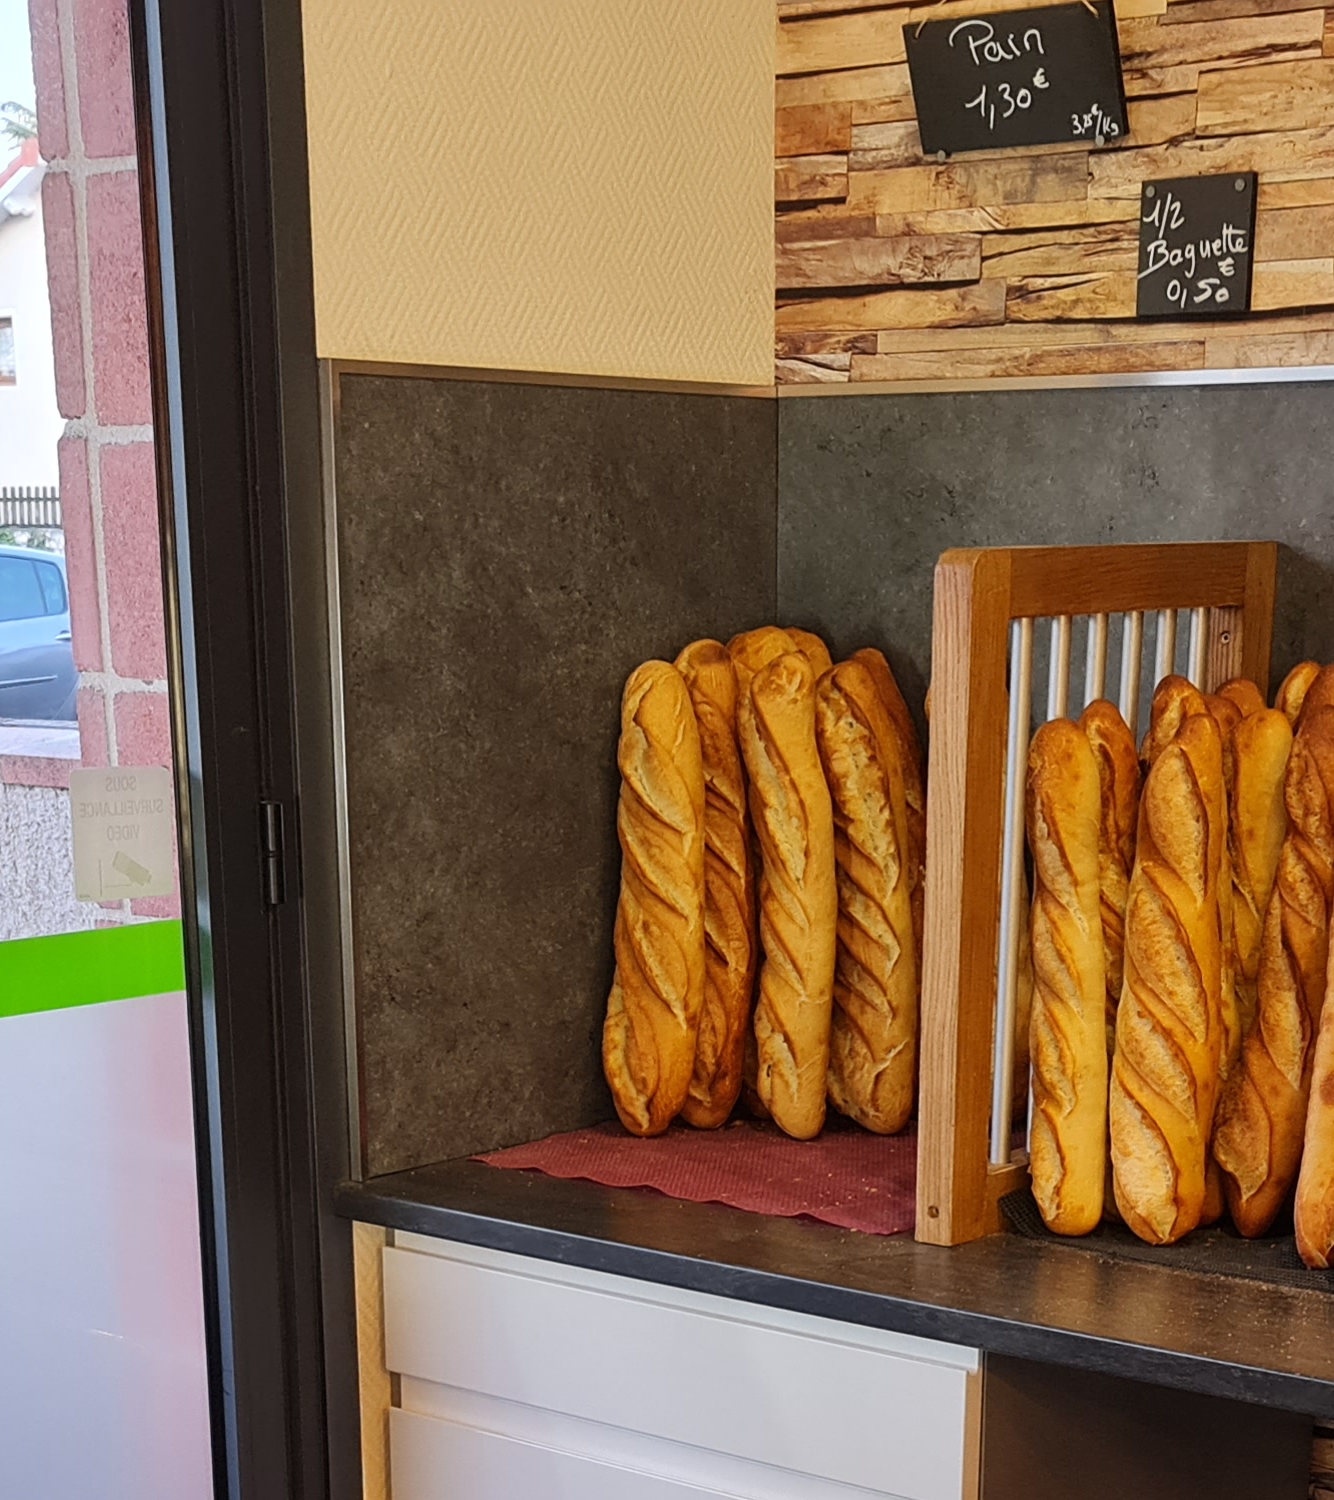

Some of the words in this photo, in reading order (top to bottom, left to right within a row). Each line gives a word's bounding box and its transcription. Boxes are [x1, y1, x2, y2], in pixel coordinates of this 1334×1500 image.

[948, 20, 1045, 66] Pain
[1142, 192, 1185, 239] 1/2
[1137, 222, 1249, 279] Baguette
